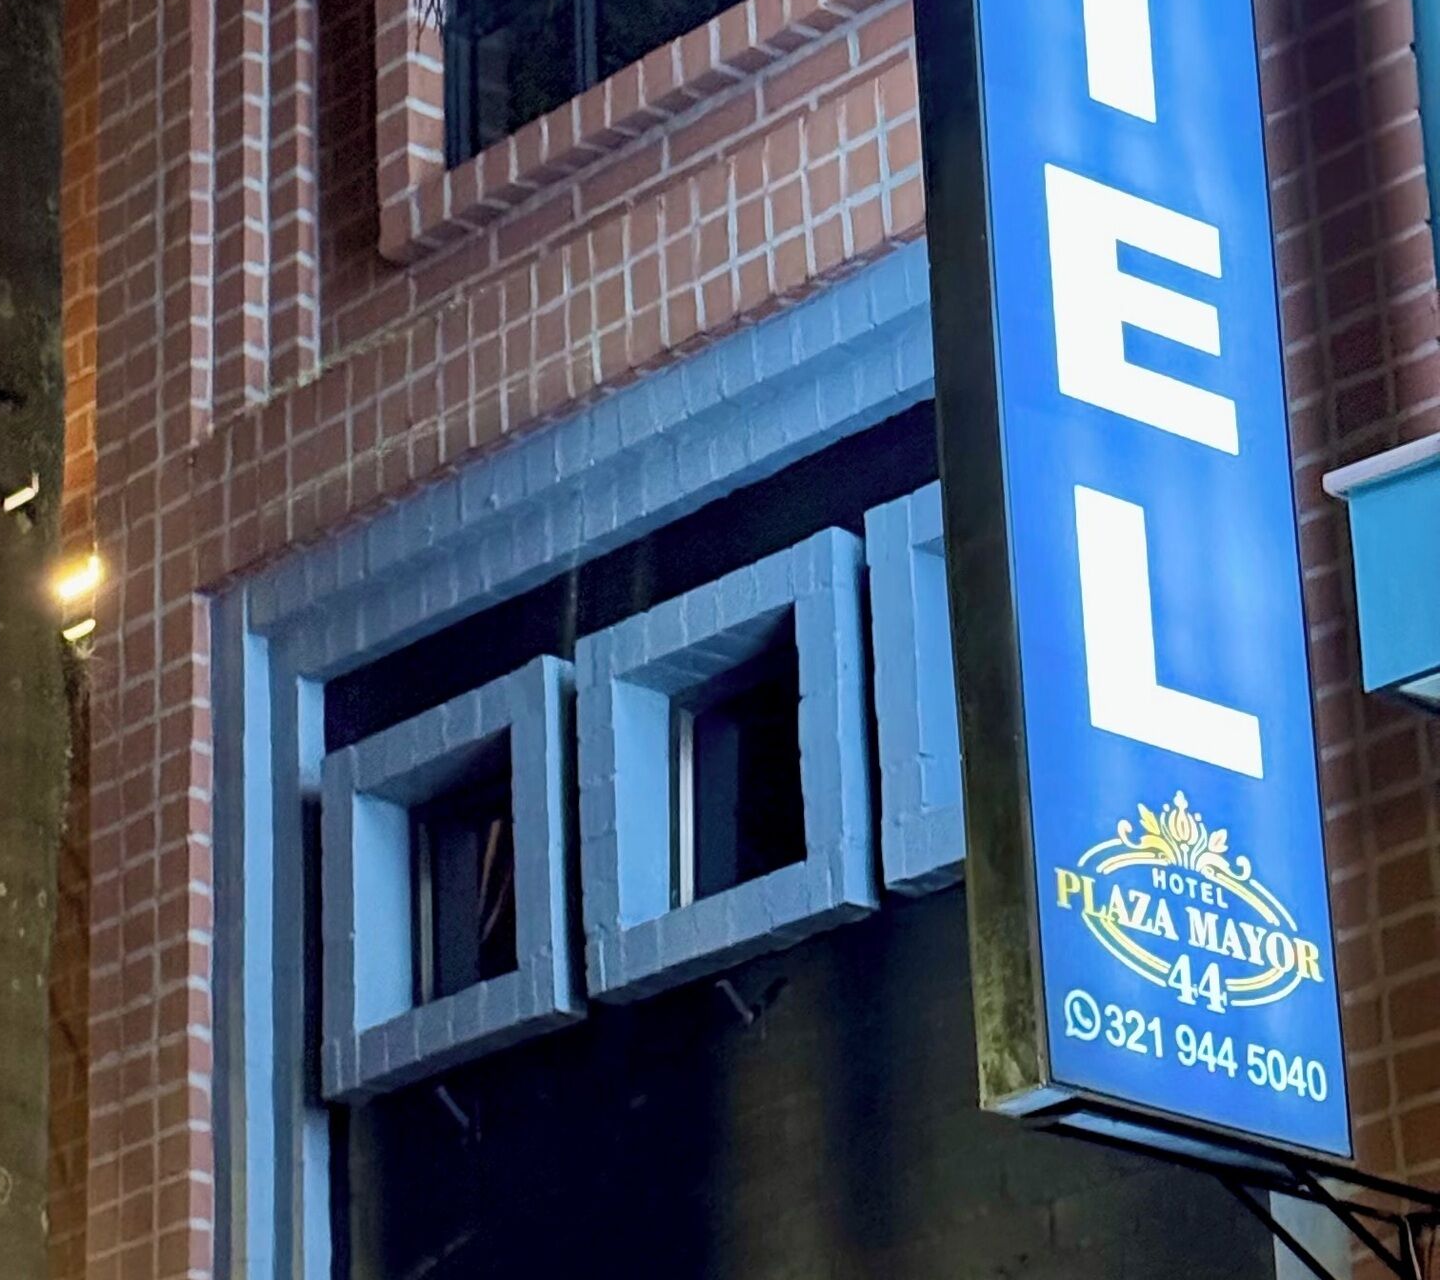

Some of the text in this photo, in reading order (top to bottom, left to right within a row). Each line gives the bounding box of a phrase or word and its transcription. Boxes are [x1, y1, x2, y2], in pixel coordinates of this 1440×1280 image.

[1055, 867, 1324, 983] PLAZA MAYOR
[1152, 868, 1228, 908] HOTEL
[1168, 954, 1227, 1014] 44
[1103, 1004, 1327, 1102] 321 944 5040
